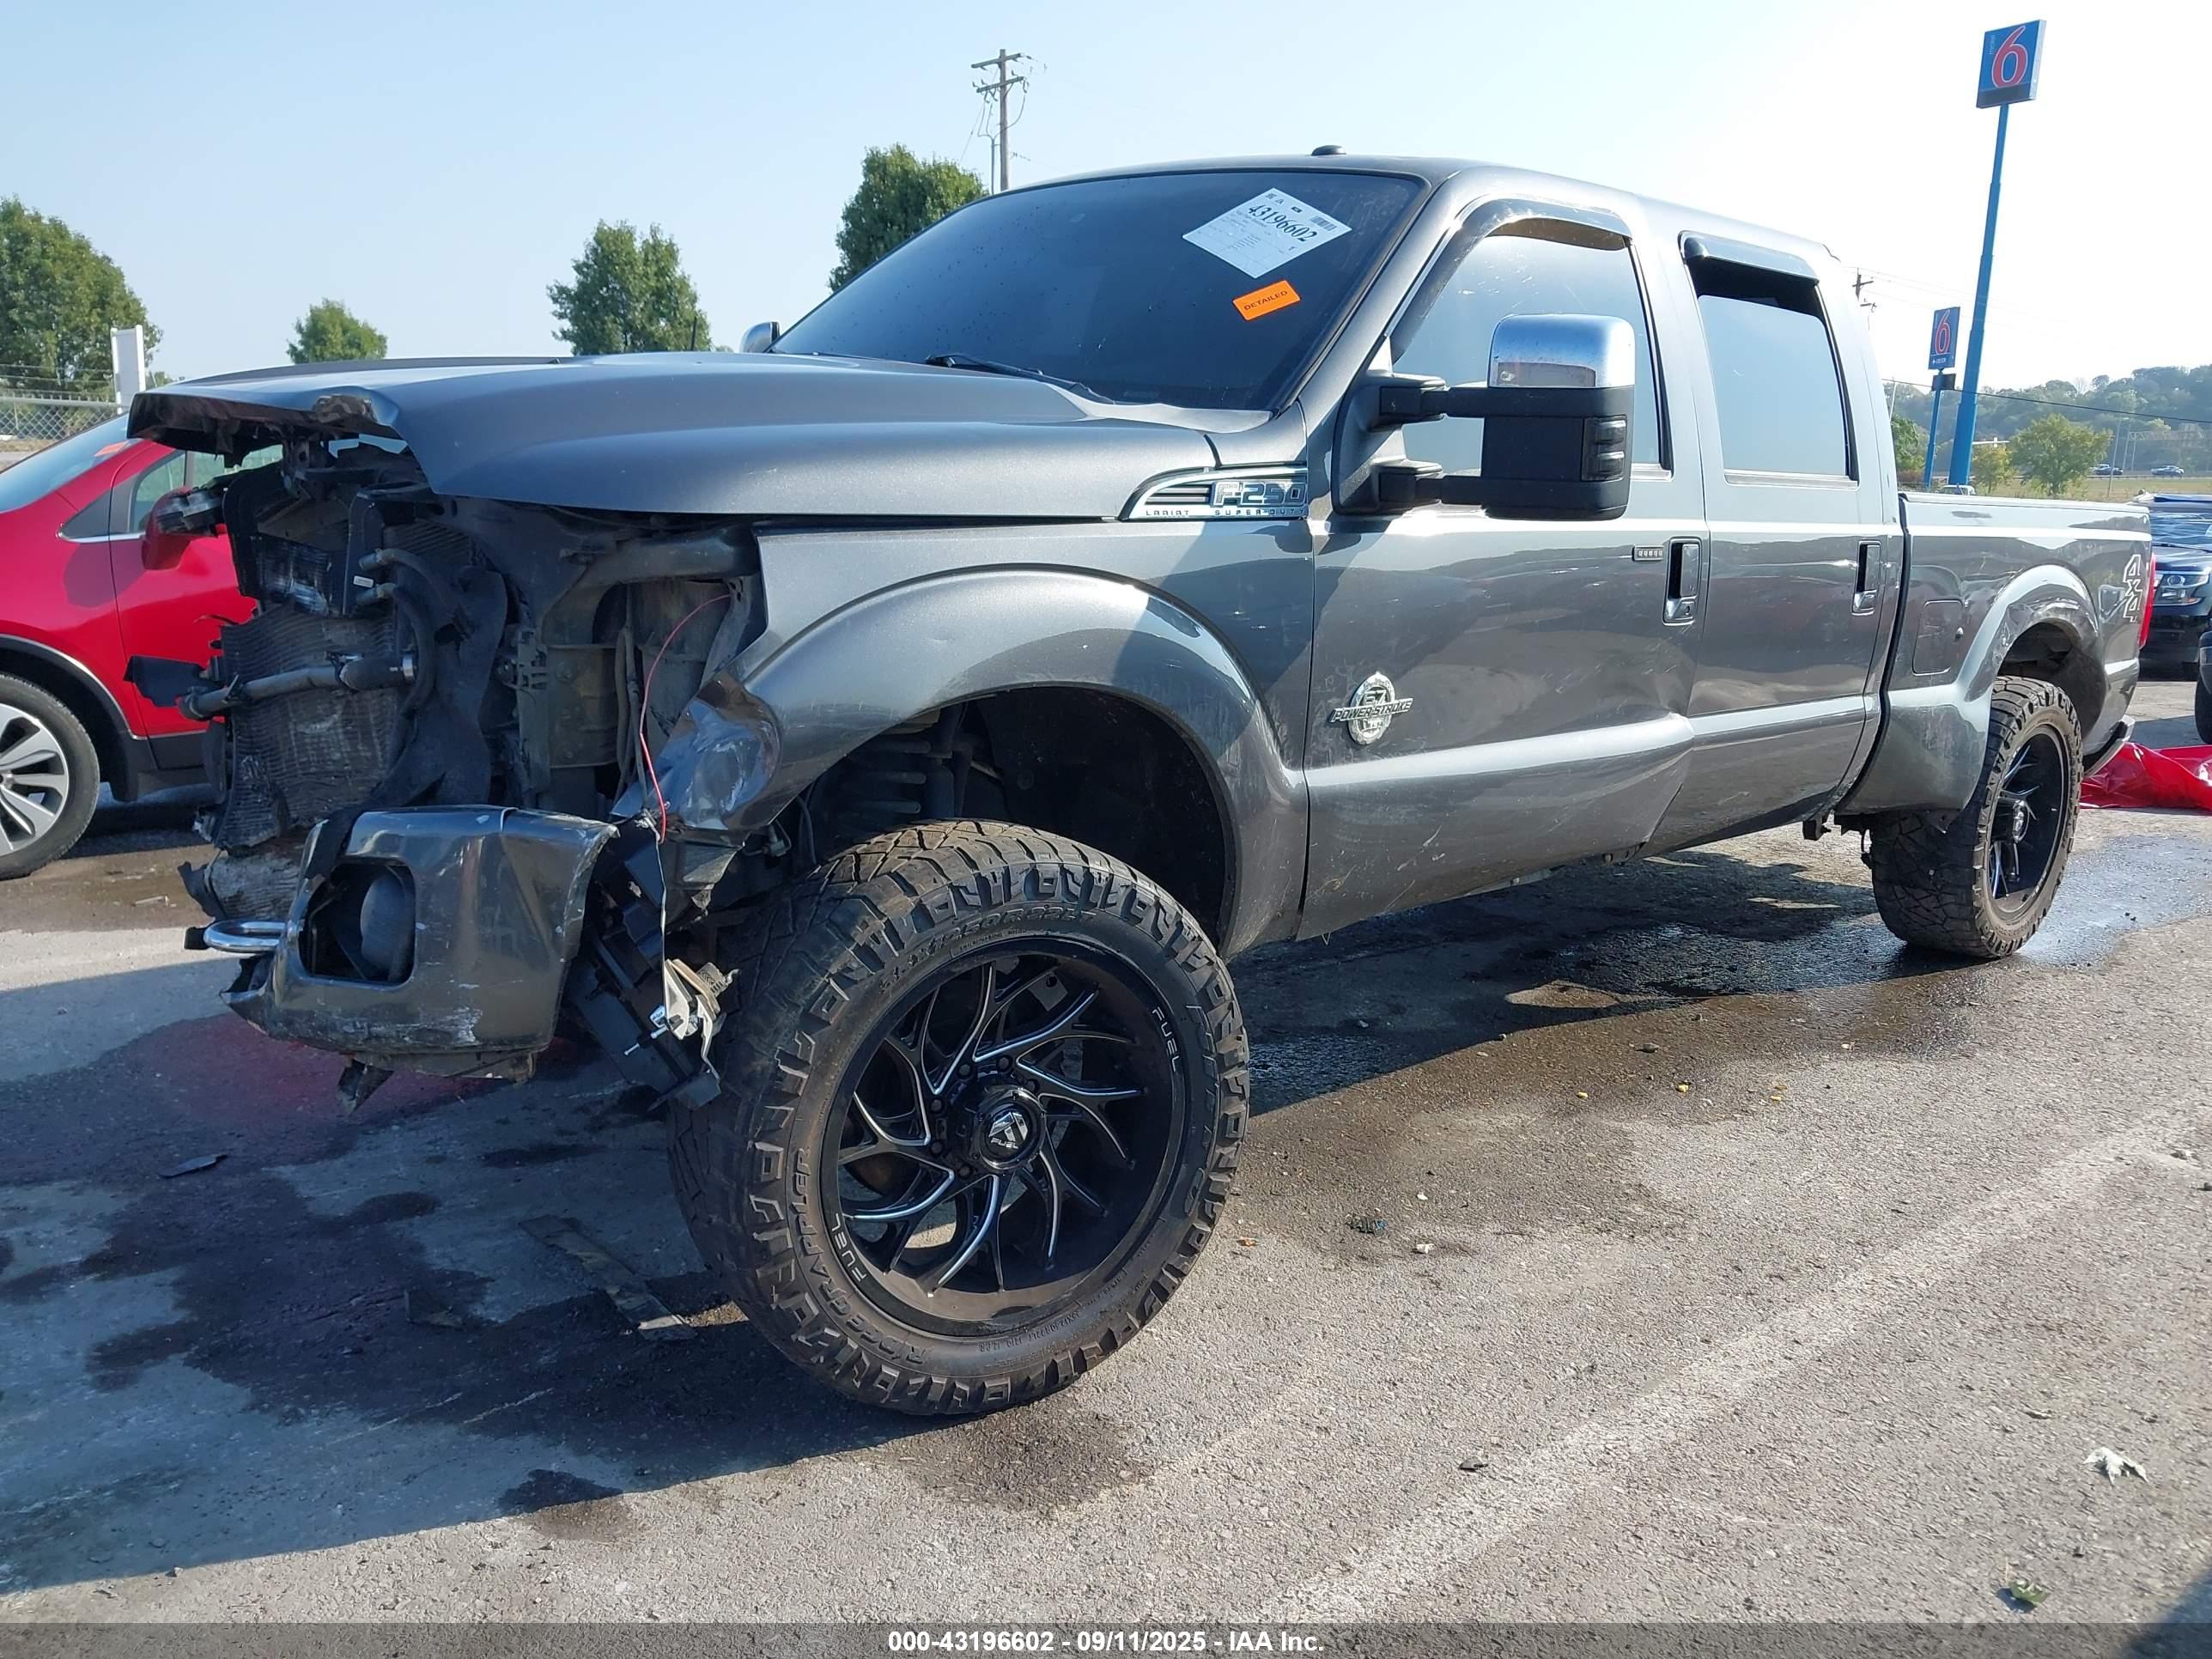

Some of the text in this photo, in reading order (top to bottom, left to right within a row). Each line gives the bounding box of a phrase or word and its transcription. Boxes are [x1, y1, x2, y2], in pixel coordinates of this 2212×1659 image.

[1991, 25, 2028, 88] 6
[1248, 204, 1318, 242] 43196602
[1243, 290, 1288, 311] DETAILED
[1935, 309, 1951, 356] 6
[1212, 481, 1307, 508] F-250
[1152, 1006, 1182, 1073] FUEL
[991, 1137, 1019, 1149] FUEL
[790, 1148, 853, 1316] GRAPPLER
[830, 1212, 868, 1282] FUEL
